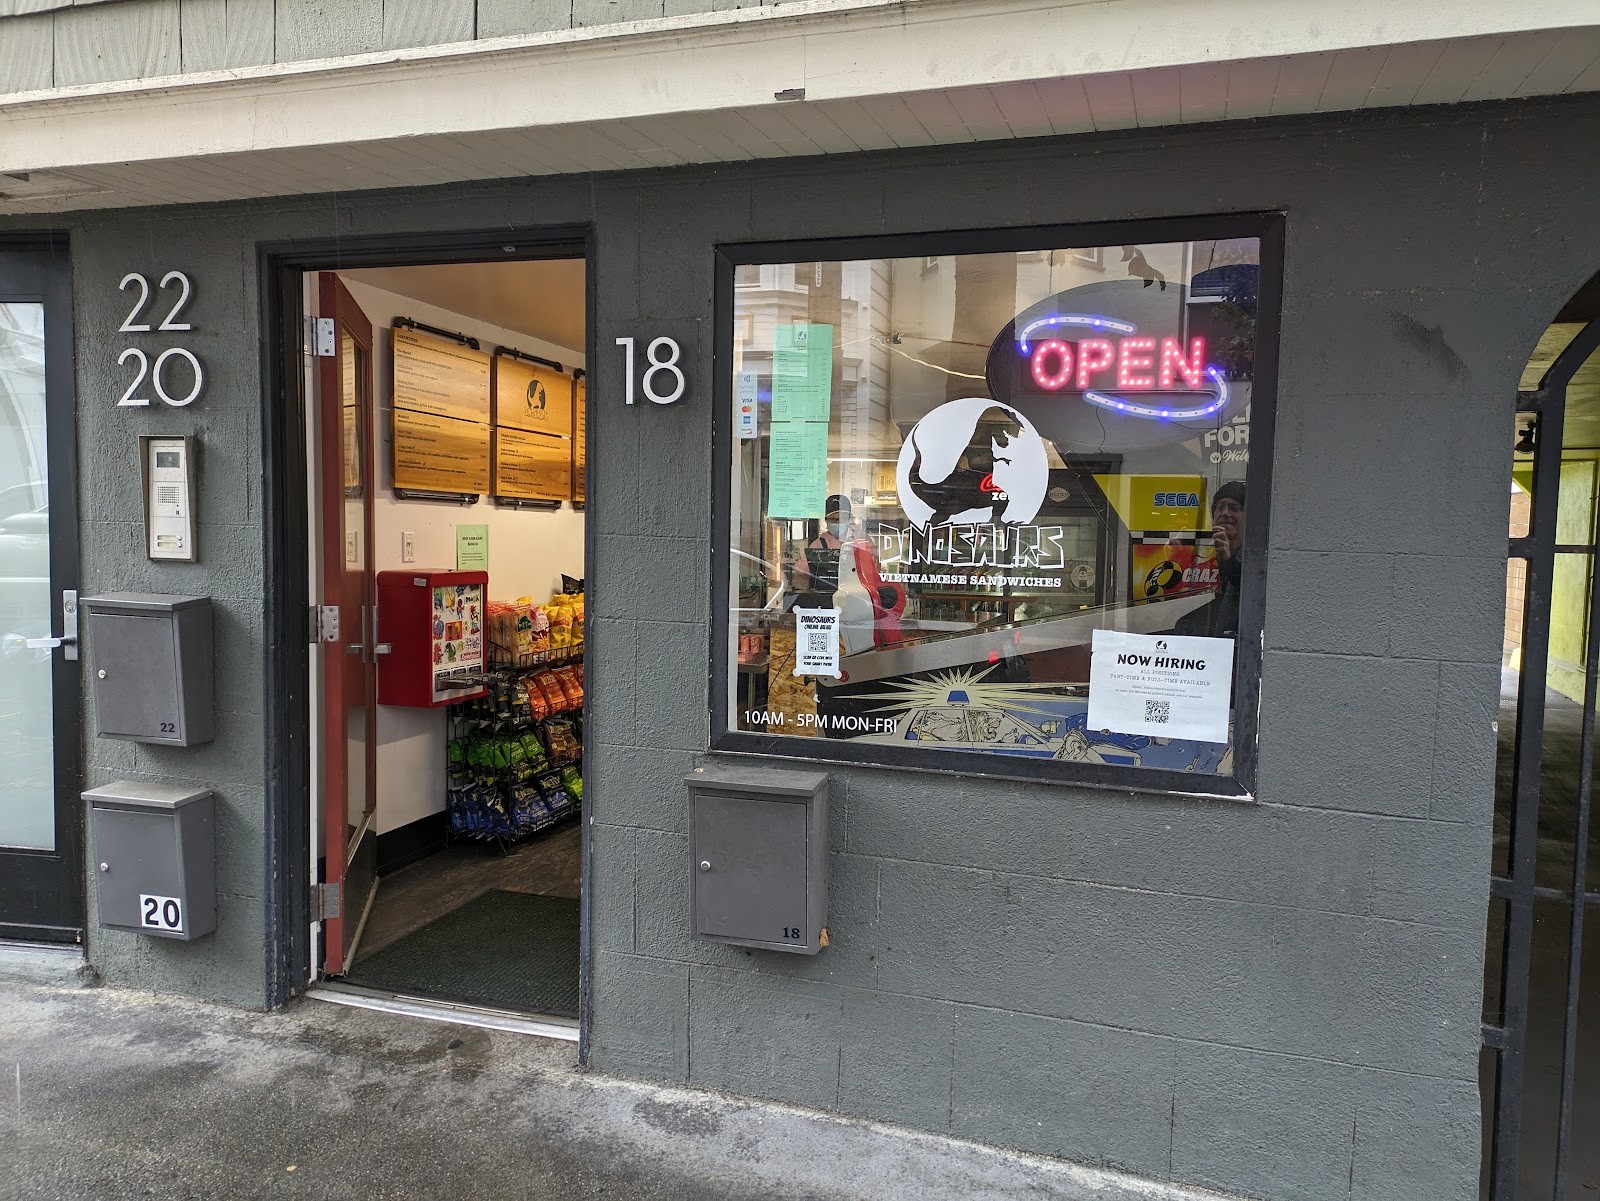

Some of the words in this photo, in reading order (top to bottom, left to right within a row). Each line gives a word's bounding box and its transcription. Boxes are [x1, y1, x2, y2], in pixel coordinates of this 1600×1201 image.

[118, 270, 191, 332] 22
[615, 336, 685, 405] 18
[1031, 336, 1206, 390] OPEN
[117, 348, 202, 407] 20
[1204, 425, 1250, 448] FOR
[991, 491, 1008, 501] ze
[1153, 493, 1200, 507] SEGA
[878, 521, 1065, 569] DINOSAURS
[879, 573, 967, 585] VIETNAMESE
[969, 575, 1062, 587] SANDWICHES
[801, 615, 836, 624] DINOSAURS
[1117, 653, 1152, 667] NOW
[1154, 656, 1206, 671] HIRING
[1109, 673, 1140, 681] PART-TIME
[160, 722, 175, 733] 22
[744, 710, 784, 725] 10AM
[797, 714, 828, 729] 5PM
[832, 715, 897, 733] MON-FRI
[144, 897, 180, 928] 20
[782, 927, 800, 939] 18
